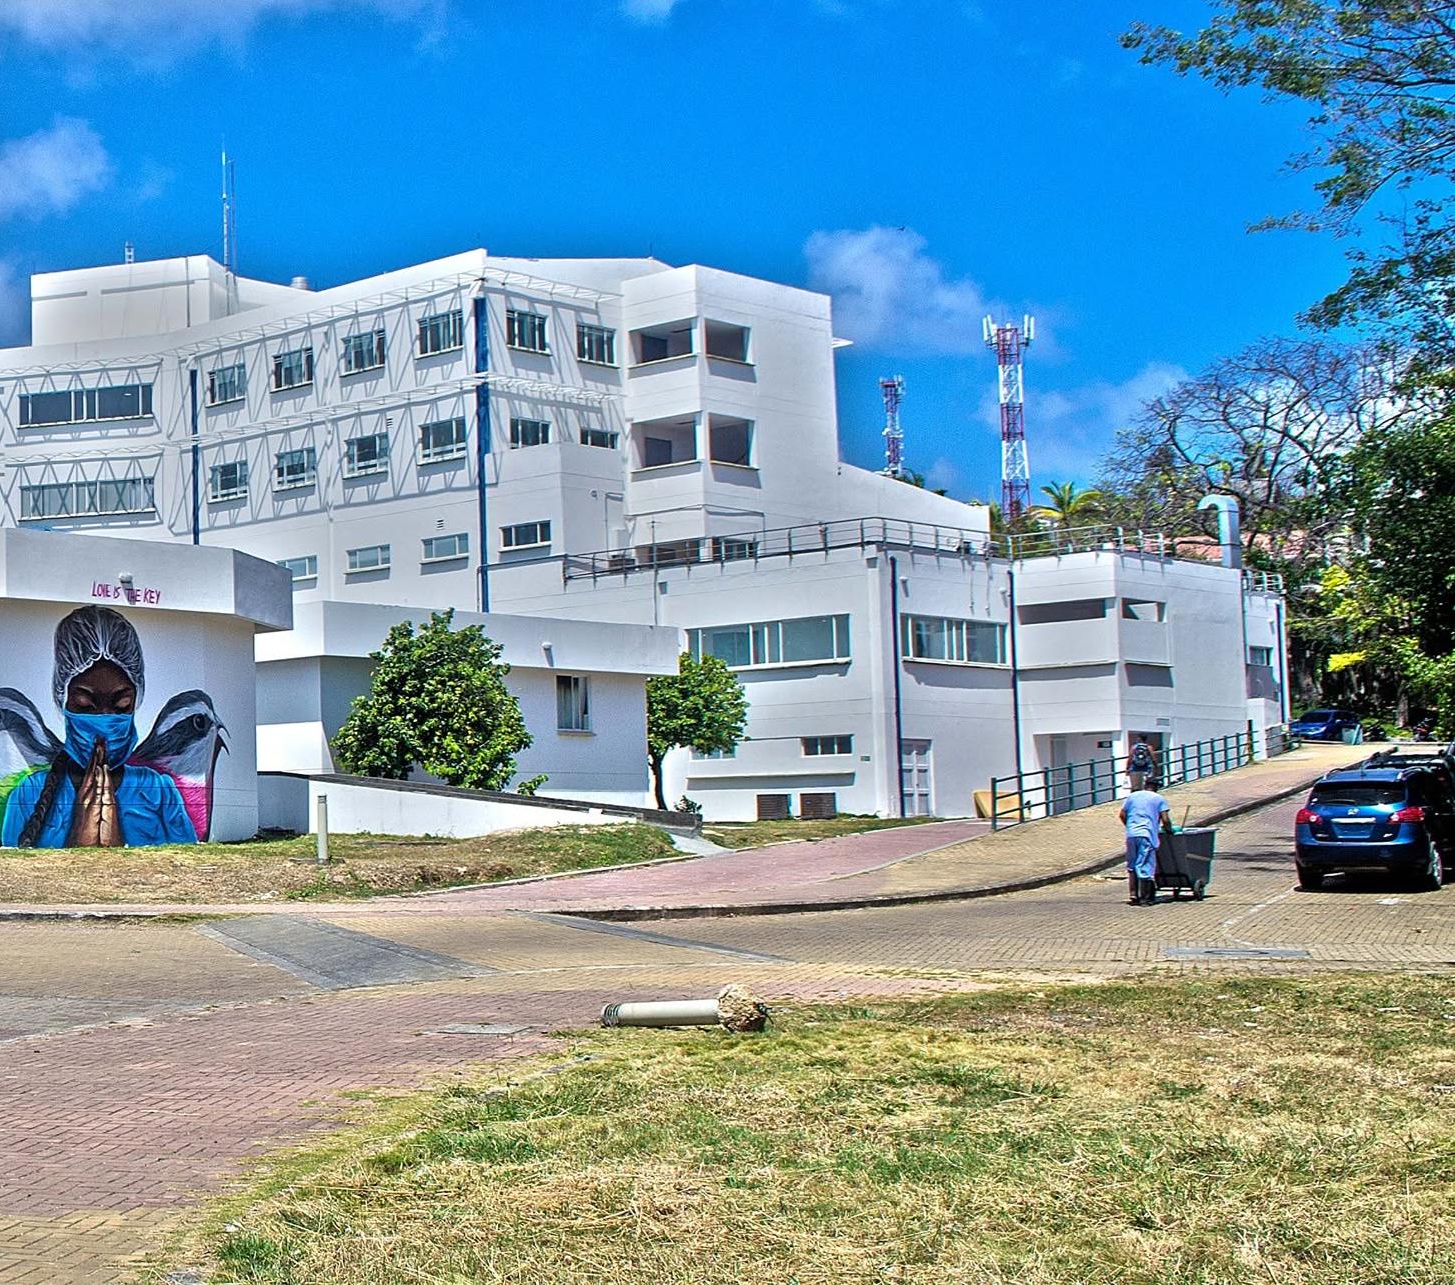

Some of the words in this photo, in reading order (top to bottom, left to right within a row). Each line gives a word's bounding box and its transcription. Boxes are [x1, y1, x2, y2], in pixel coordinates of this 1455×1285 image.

[91, 581, 111, 597] LOVE
[113, 585, 122, 599] IS
[125, 588, 141, 603] THE
[143, 588, 161, 605] KEY
